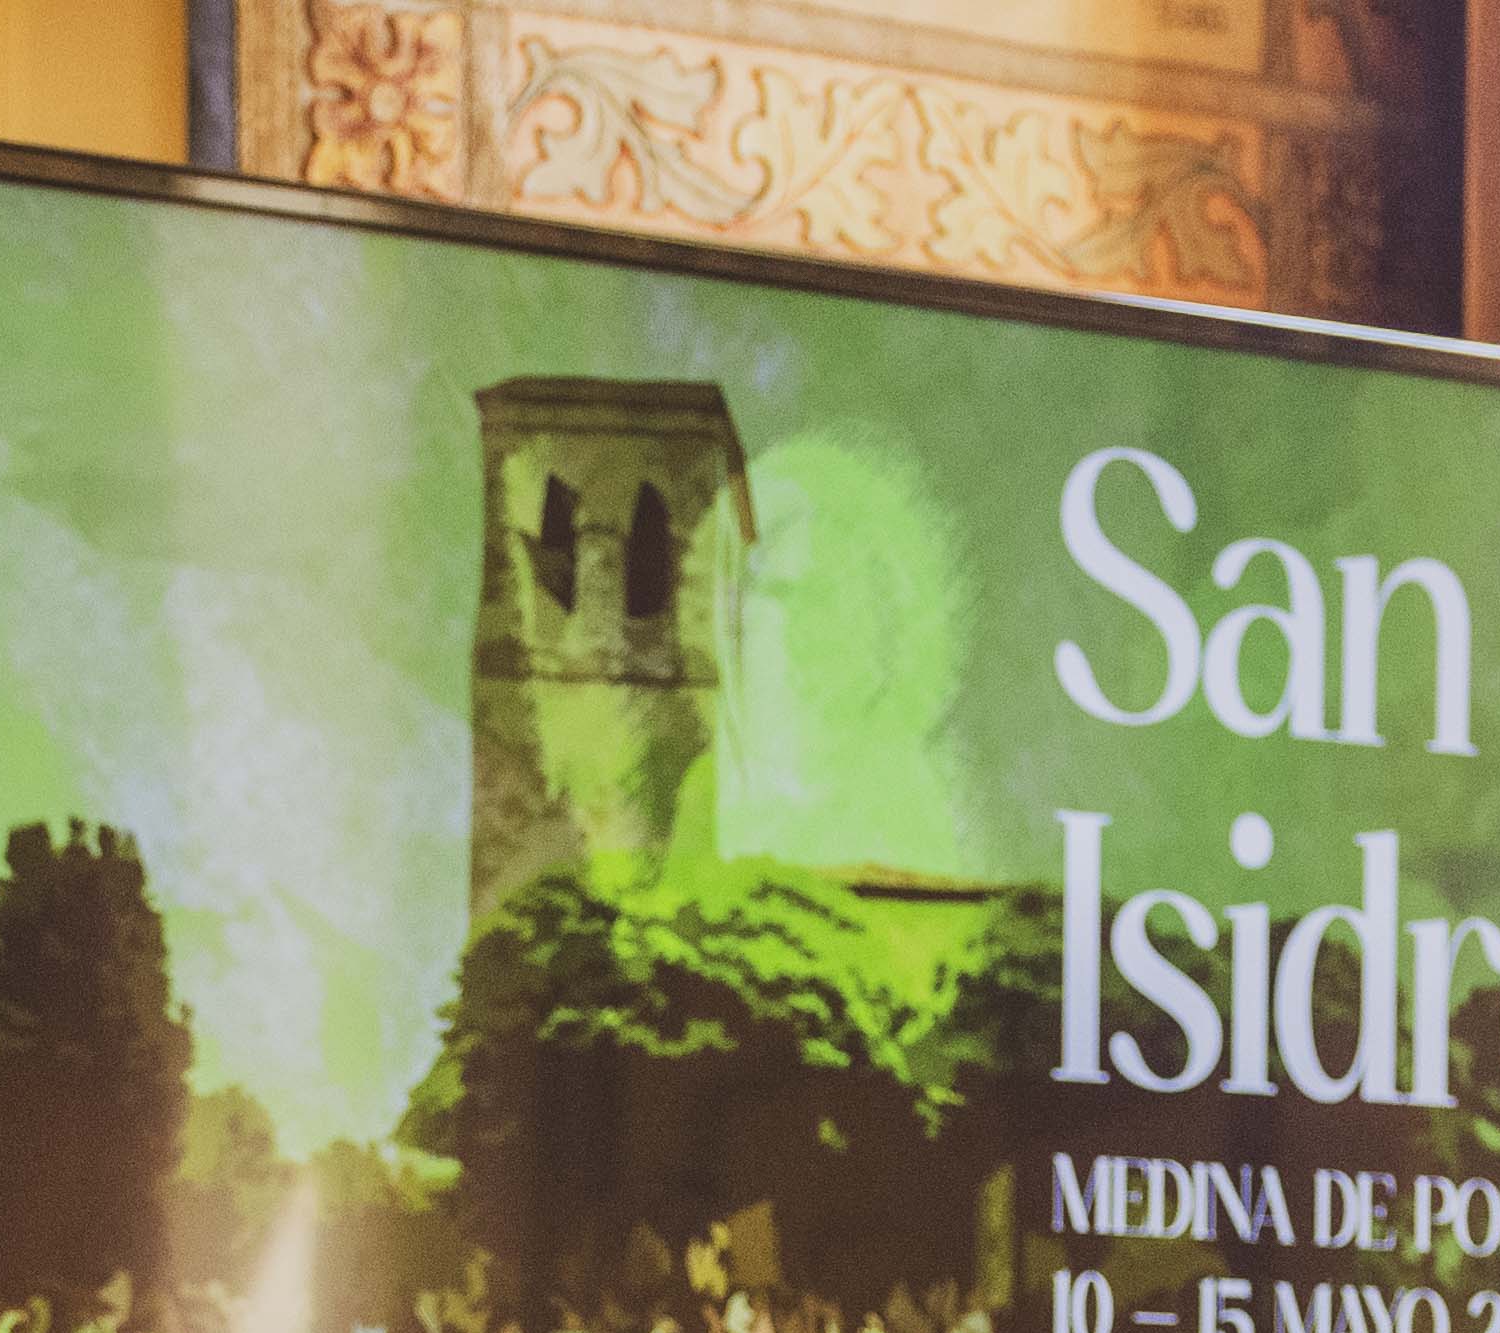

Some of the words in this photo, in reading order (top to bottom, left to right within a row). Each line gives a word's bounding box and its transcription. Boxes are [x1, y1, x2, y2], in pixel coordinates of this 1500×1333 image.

[1053, 446, 1478, 756] San
[1051, 1152, 1295, 1246] MEDINA
[1313, 1168, 1397, 1252] DE
